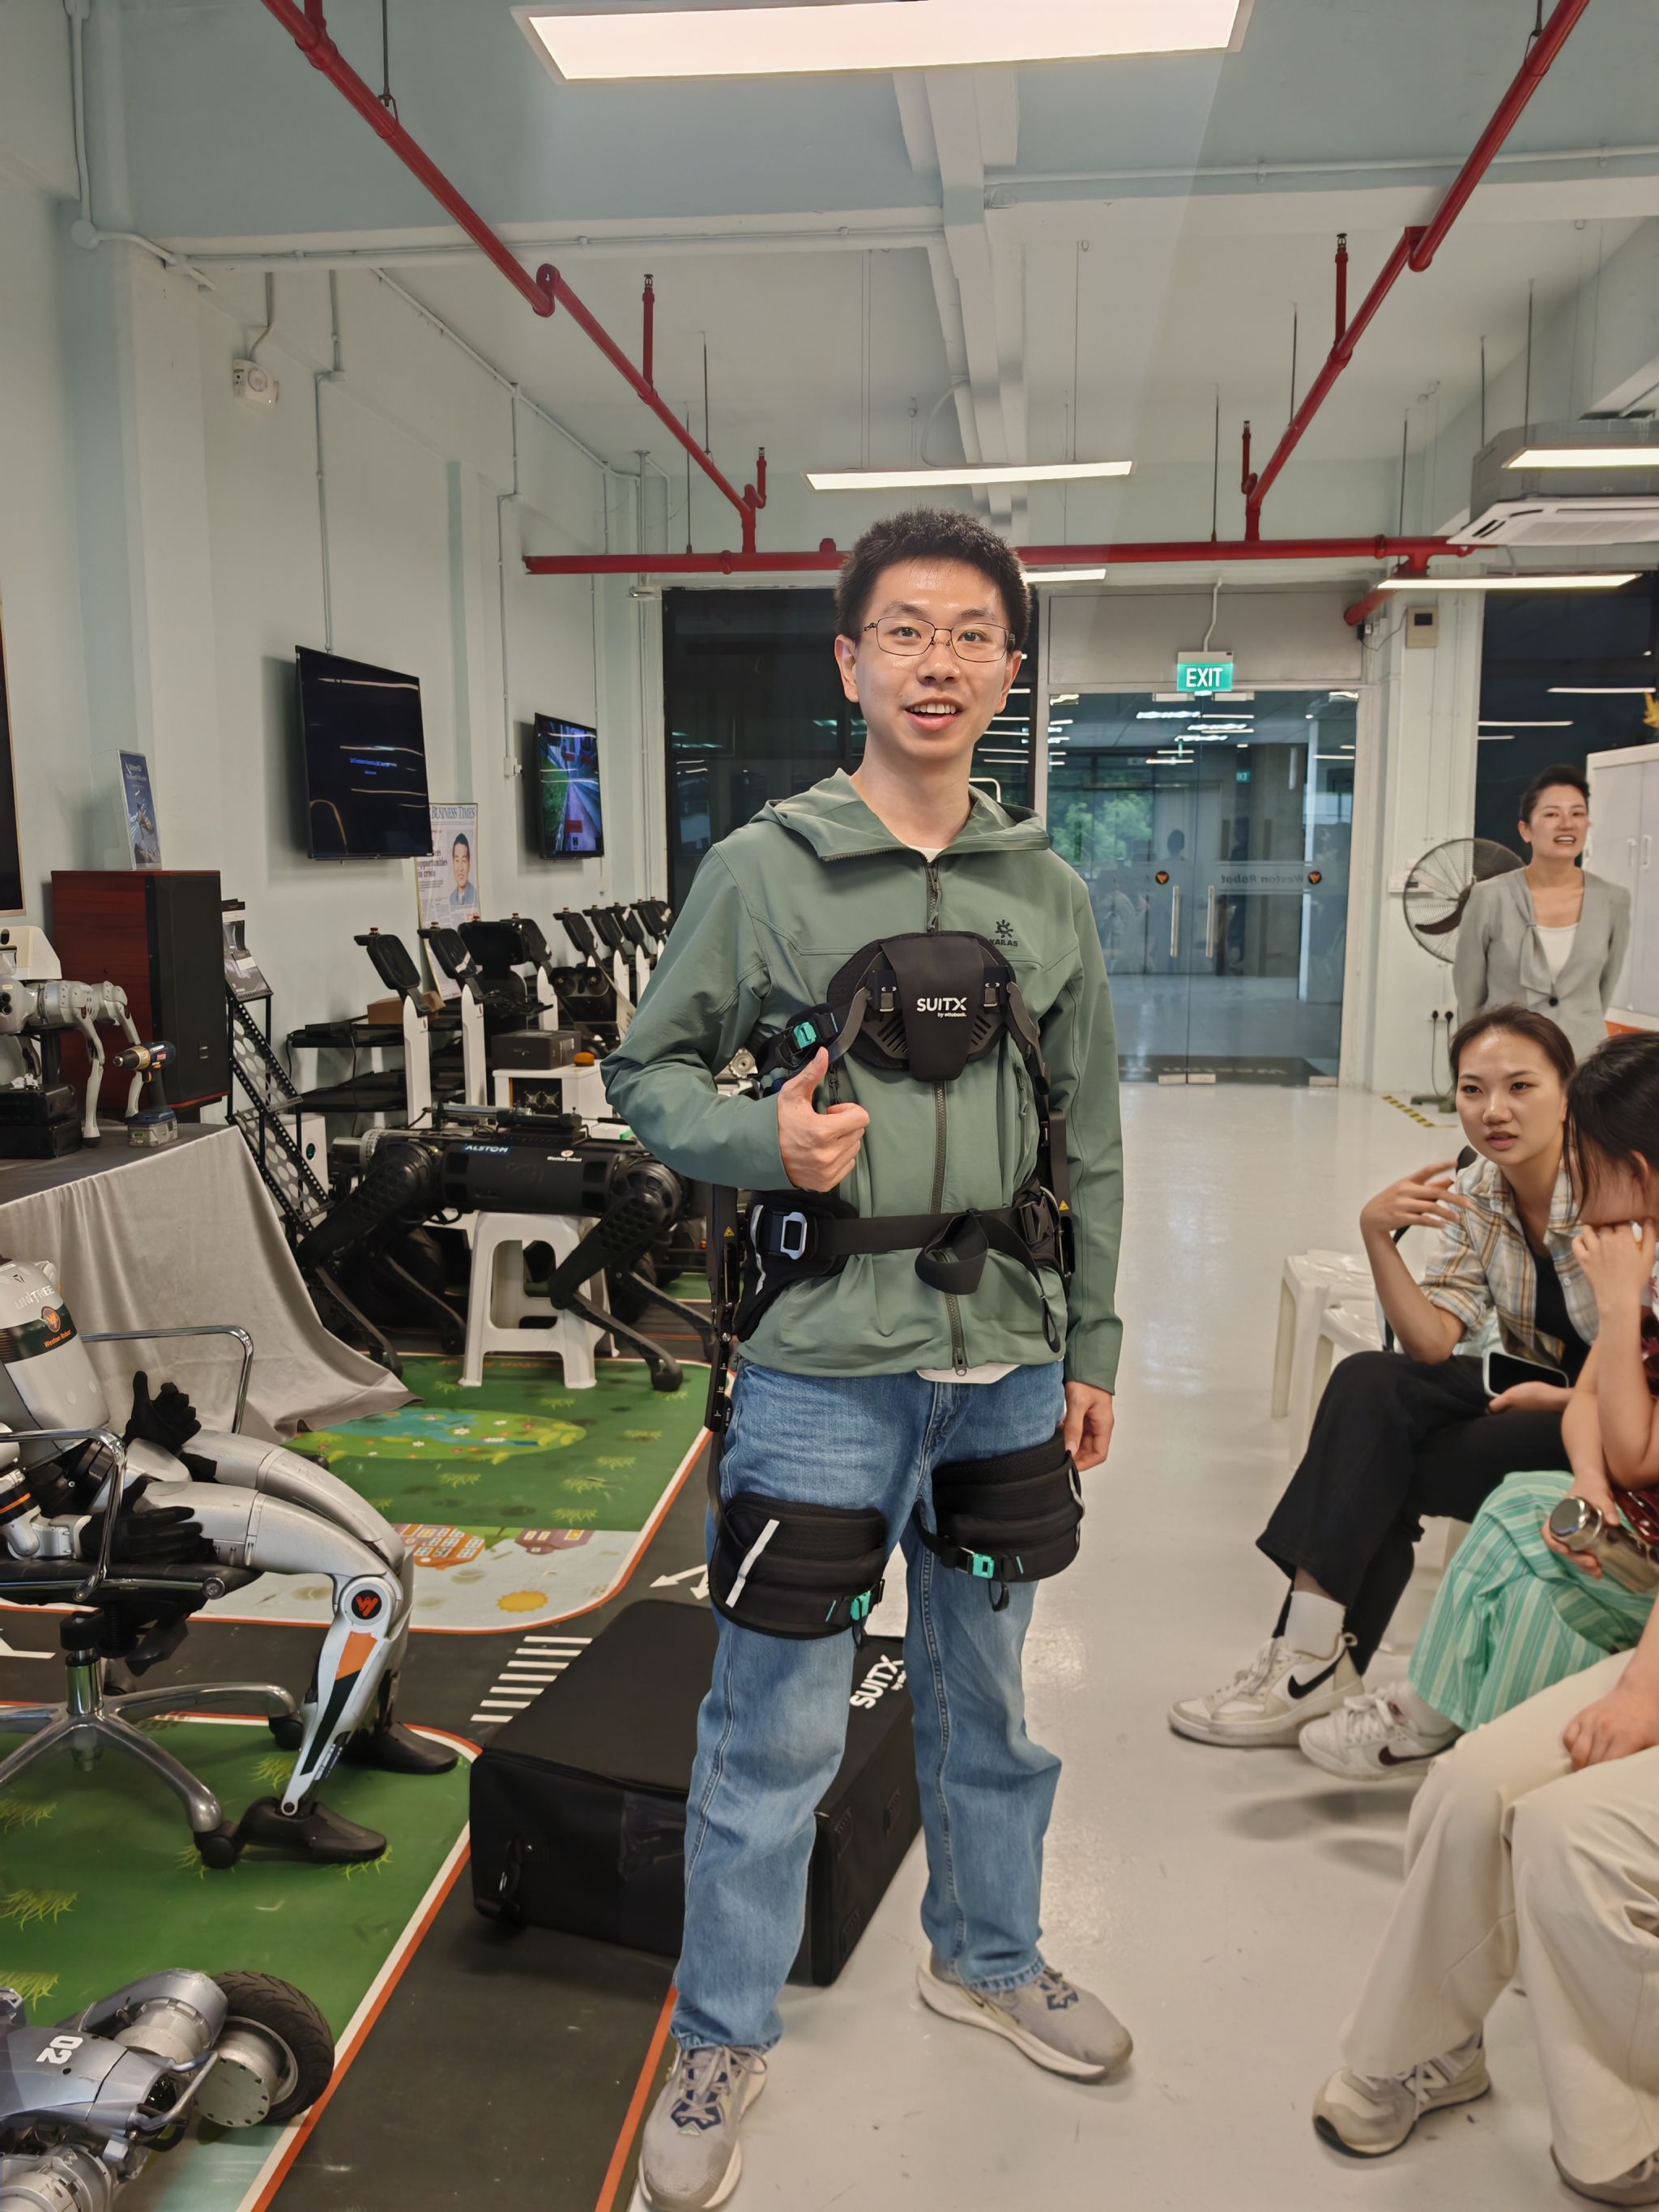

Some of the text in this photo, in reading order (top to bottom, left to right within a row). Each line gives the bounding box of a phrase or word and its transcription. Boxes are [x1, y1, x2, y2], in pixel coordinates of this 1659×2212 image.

[1186, 668, 1223, 687] EXIT
[432, 805, 458, 819] BUSINESS
[458, 805, 476, 819] TIMES
[916, 997, 967, 1012] SUITX
[465, 1145, 509, 1153] ALSTON
[15, 1285, 54, 1309] UNITREE
[849, 1655, 905, 1710] SUITX
[36, 2035, 83, 2065] 02
